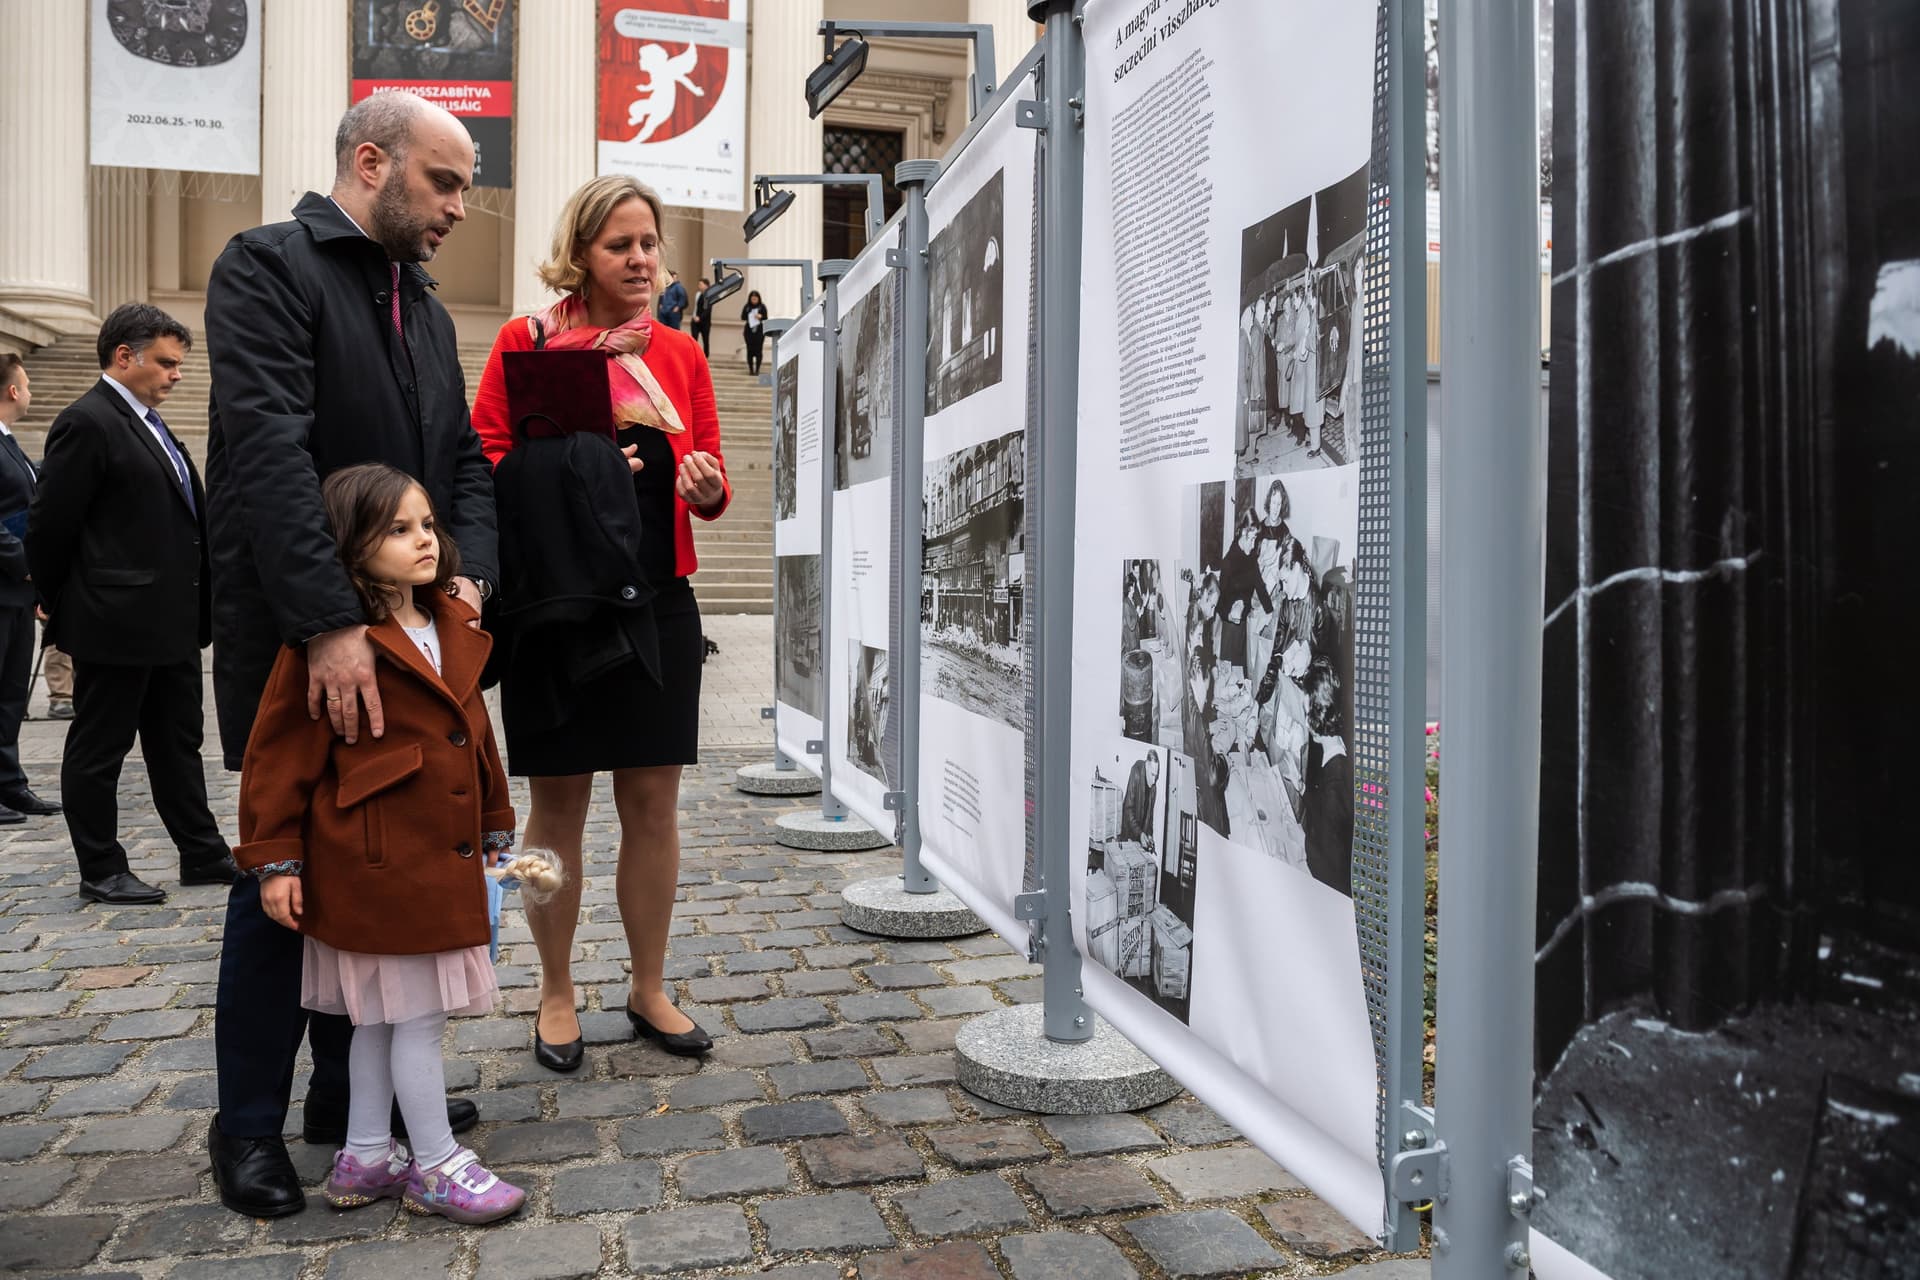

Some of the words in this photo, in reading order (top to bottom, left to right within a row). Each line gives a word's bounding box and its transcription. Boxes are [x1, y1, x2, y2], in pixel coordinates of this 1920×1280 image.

[1113, 27, 1157, 83] szczecini
[1160, 0, 1219, 42] visszha
[1114, 27, 1123, 50] A
